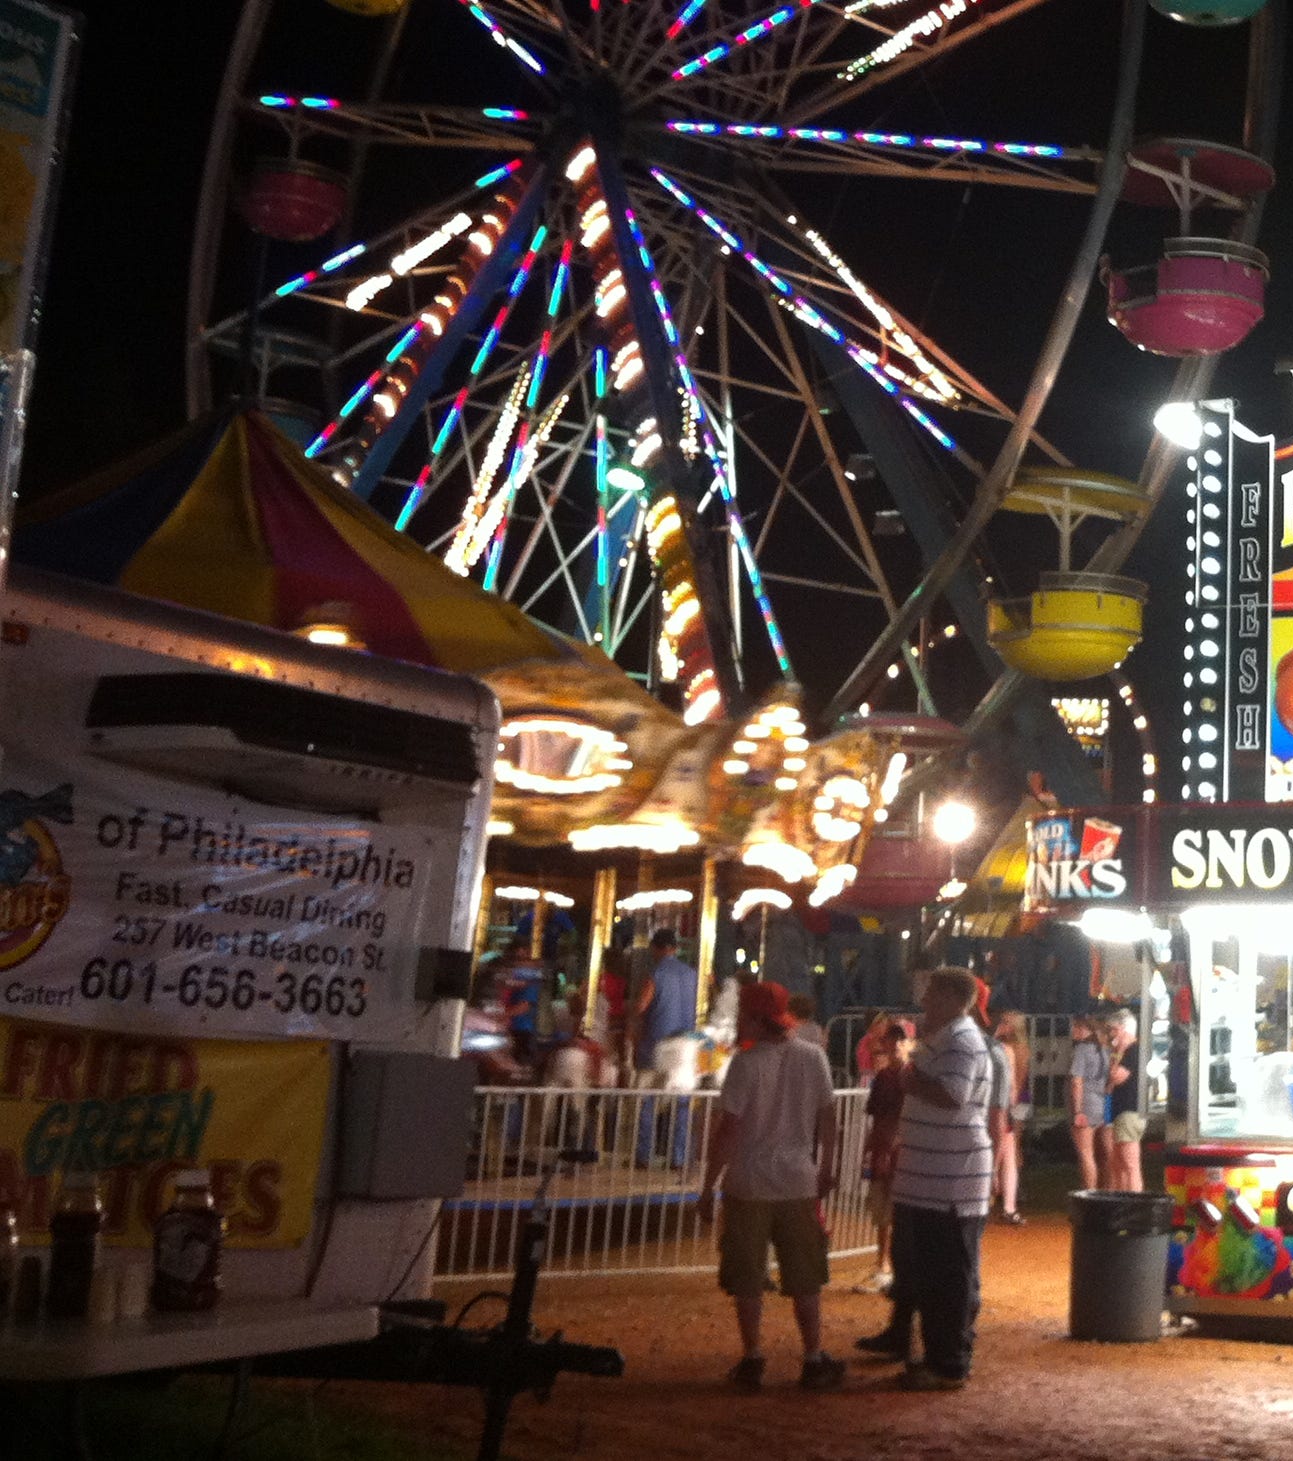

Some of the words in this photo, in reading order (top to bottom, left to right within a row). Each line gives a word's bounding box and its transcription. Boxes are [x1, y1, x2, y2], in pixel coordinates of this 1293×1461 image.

[1236, 481, 1262, 751] FRESH
[98, 808, 148, 850] of
[158, 811, 416, 889] Philadelphia
[113, 914, 167, 946] 257
[172, 921, 241, 956] West
[248, 930, 354, 968] Beacon
[201, 884, 294, 921] Casual
[301, 898, 387, 939] Dining
[80, 956, 369, 1018] 601-656-3663
[5, 1031, 198, 1100] FRIED
[25, 1088, 217, 1177] GREEN
